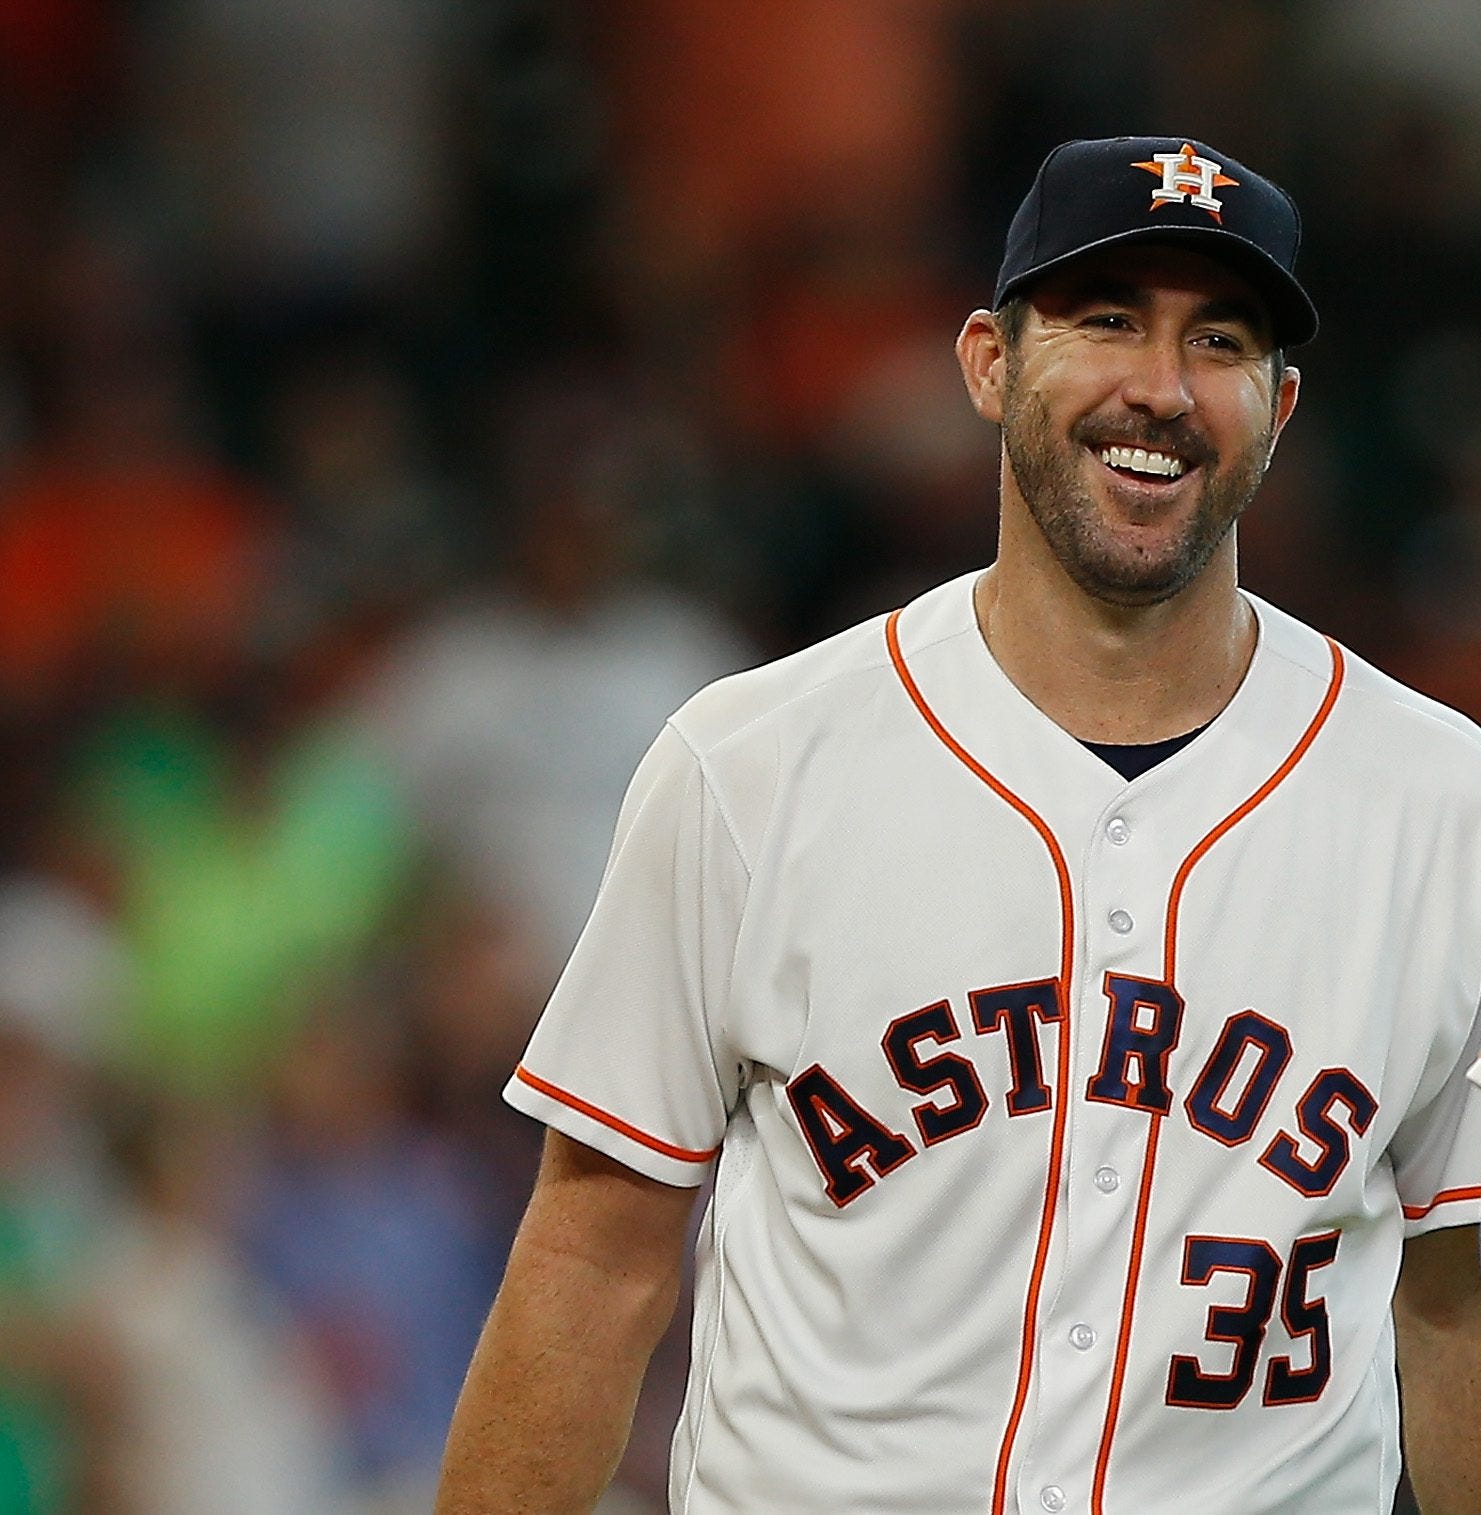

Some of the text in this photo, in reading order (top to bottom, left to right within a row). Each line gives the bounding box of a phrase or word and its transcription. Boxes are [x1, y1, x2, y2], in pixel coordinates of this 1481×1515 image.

[1151, 153, 1223, 212] H
[785, 971, 1380, 1209] ASTROS
[1165, 1229, 1342, 1409] 35
